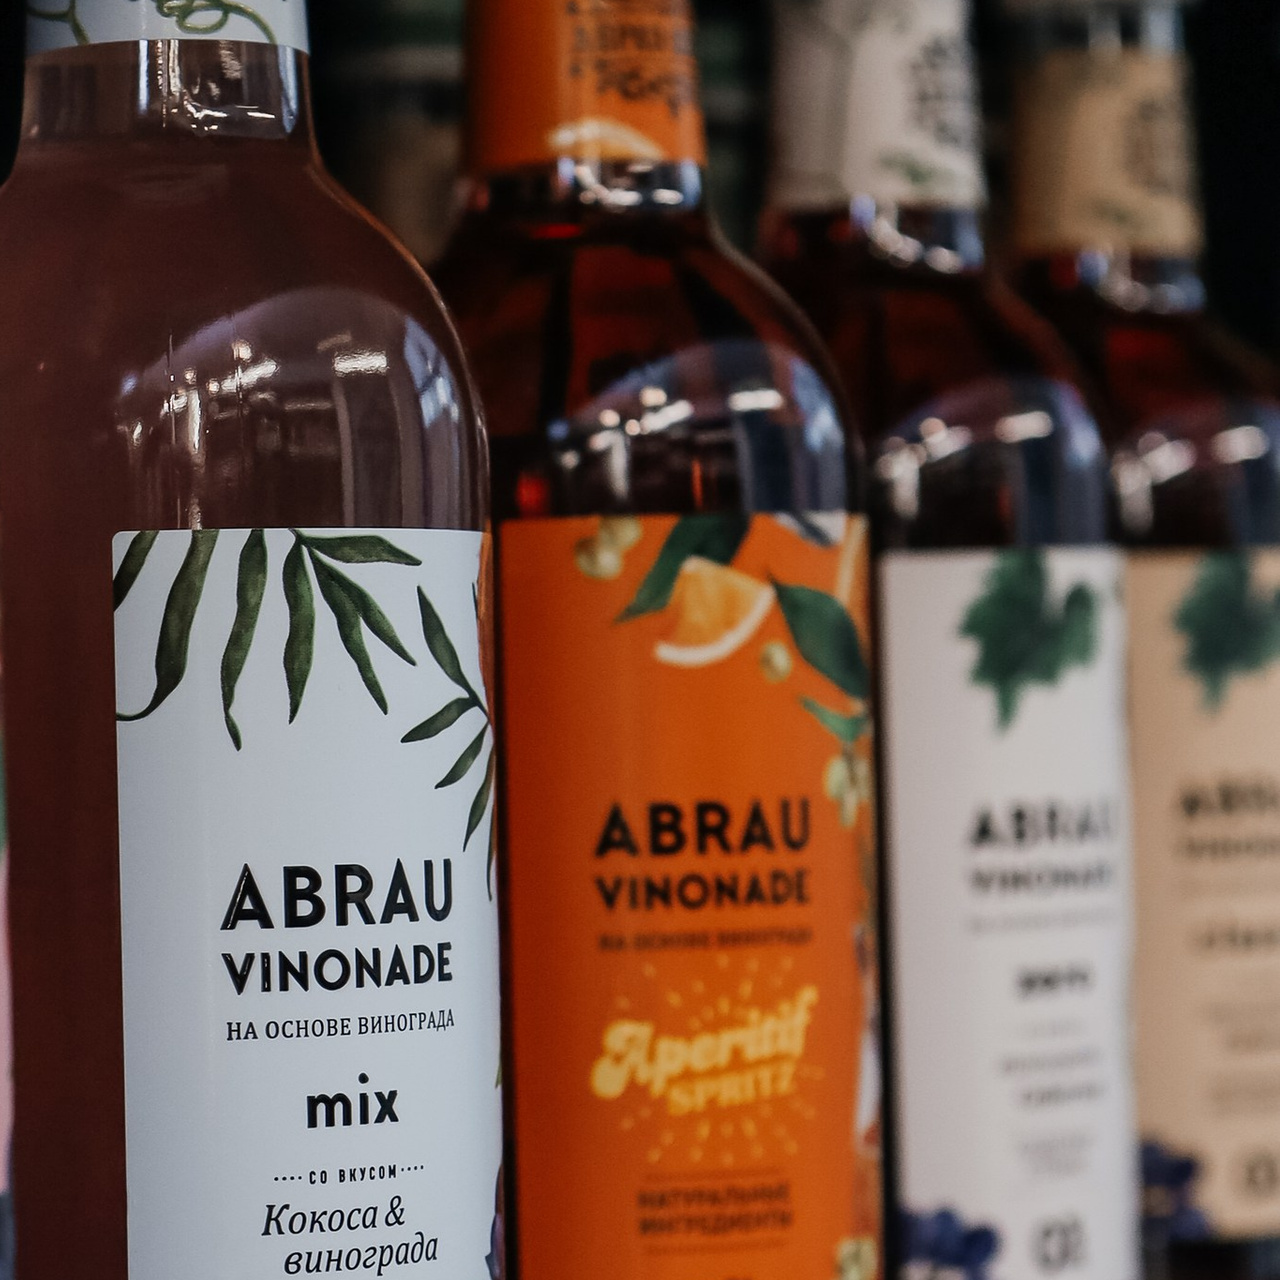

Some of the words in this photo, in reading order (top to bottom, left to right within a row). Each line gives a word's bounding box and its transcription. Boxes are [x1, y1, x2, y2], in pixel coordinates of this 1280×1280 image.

[595, 797, 811, 859] ABRAU
[220, 858, 453, 930] ABRAU
[594, 868, 810, 911] VINONADE
[221, 942, 453, 995] VINONADE
[227, 1021, 258, 1041] НА
[265, 1018, 351, 1039] ОСНОВЕ
[358, 1008, 455, 1037] ВИНОГРАДА
[306, 1072, 399, 1130] mix
[308, 1169, 328, 1185] СО
[338, 1164, 398, 1183] ВКУСОМ
[261, 1202, 378, 1237] Кокоса
[384, 1195, 406, 1227] &
[283, 1231, 438, 1277] винограда
